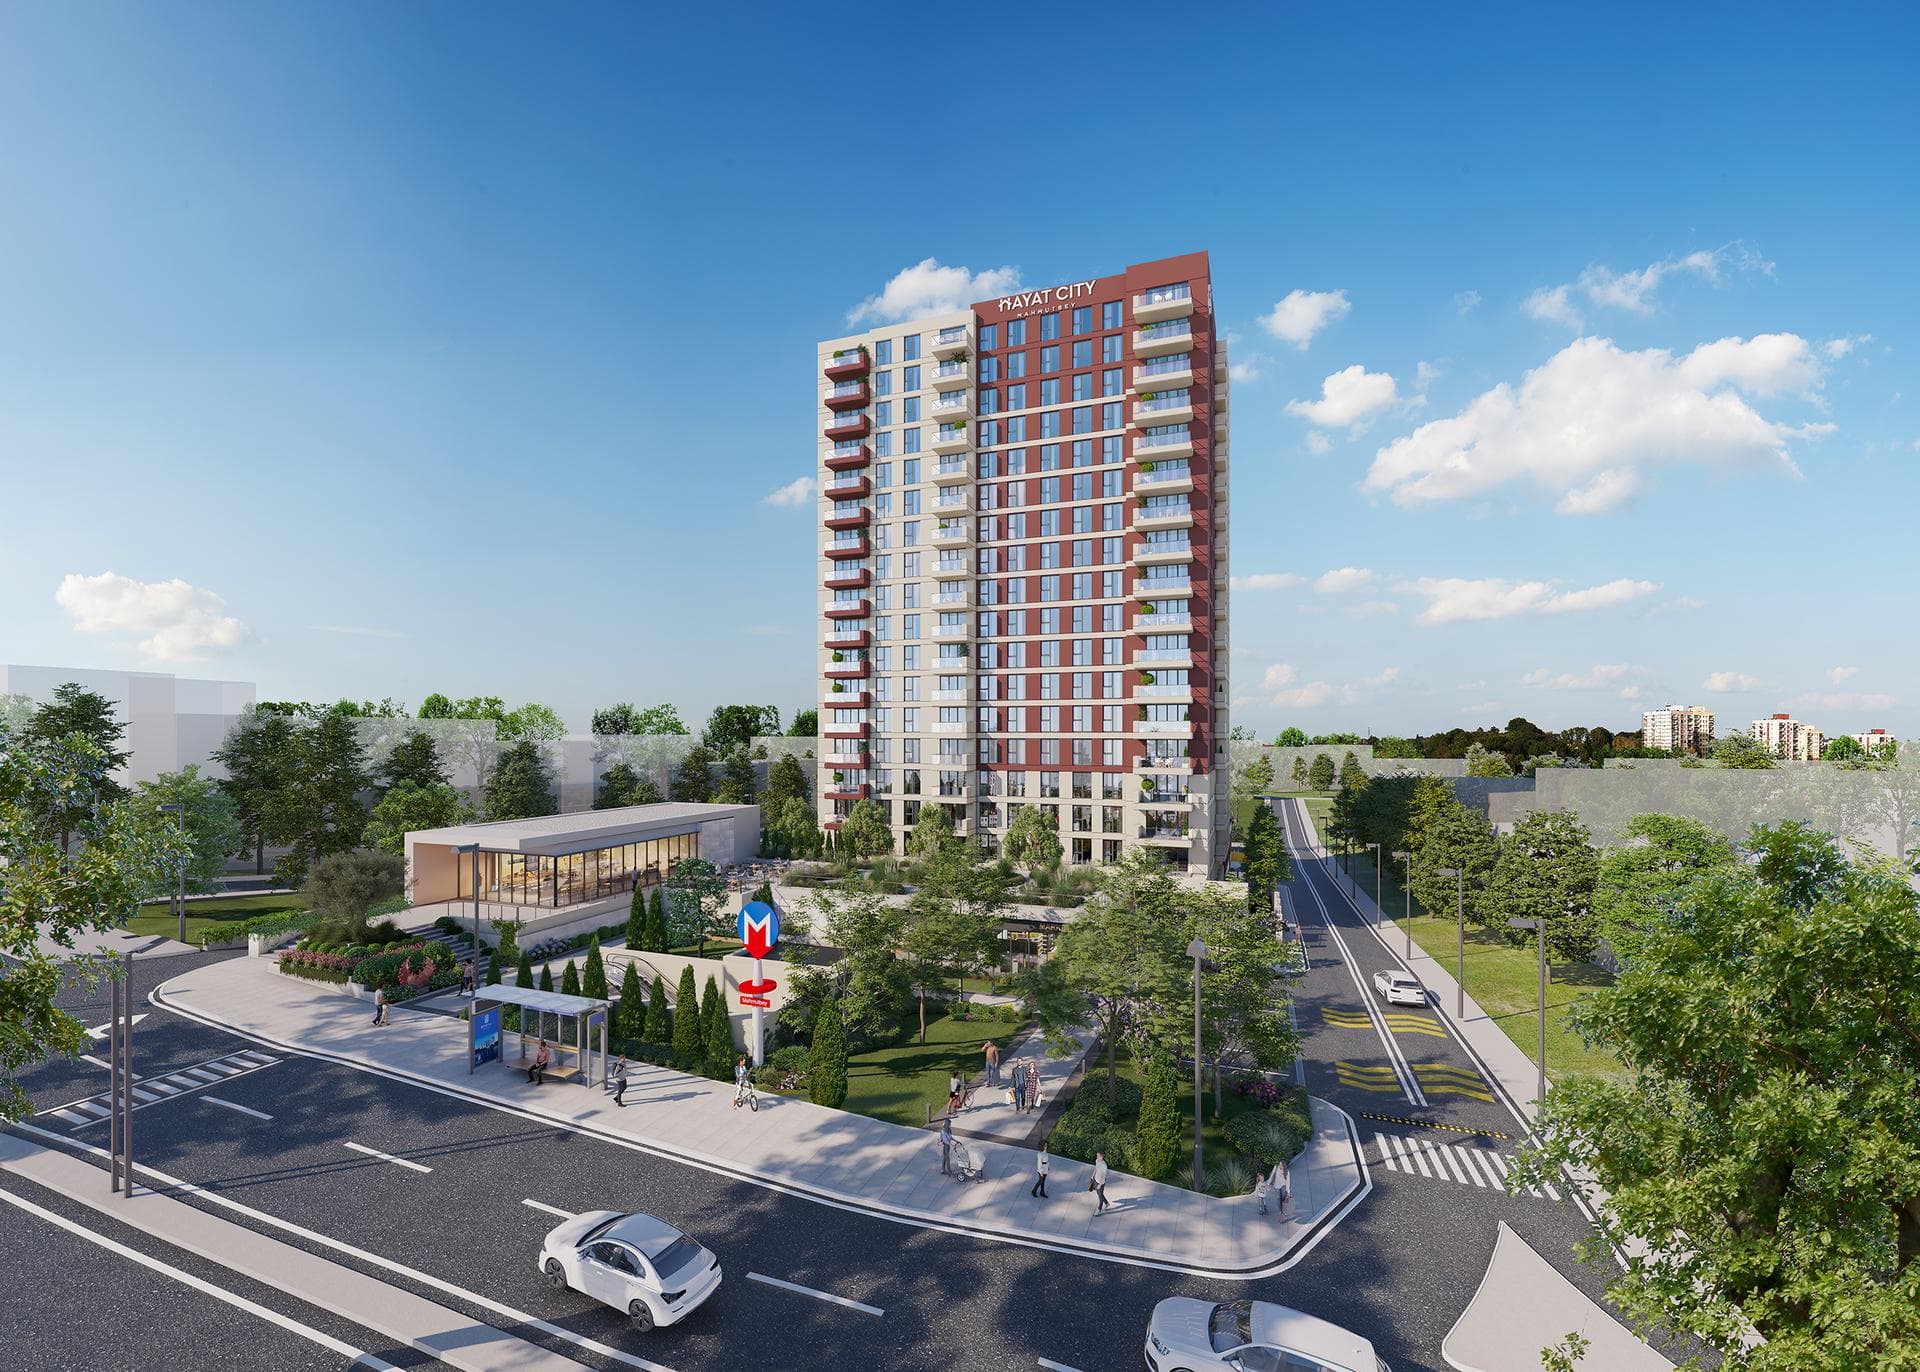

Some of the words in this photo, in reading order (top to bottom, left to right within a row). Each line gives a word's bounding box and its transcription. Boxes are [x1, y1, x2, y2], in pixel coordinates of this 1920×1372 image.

[998, 289, 1052, 312] HAYAT
[1056, 280, 1097, 301] CITY
[1017, 302, 1076, 318] MAHMUTBEY
[744, 910, 771, 947] M
